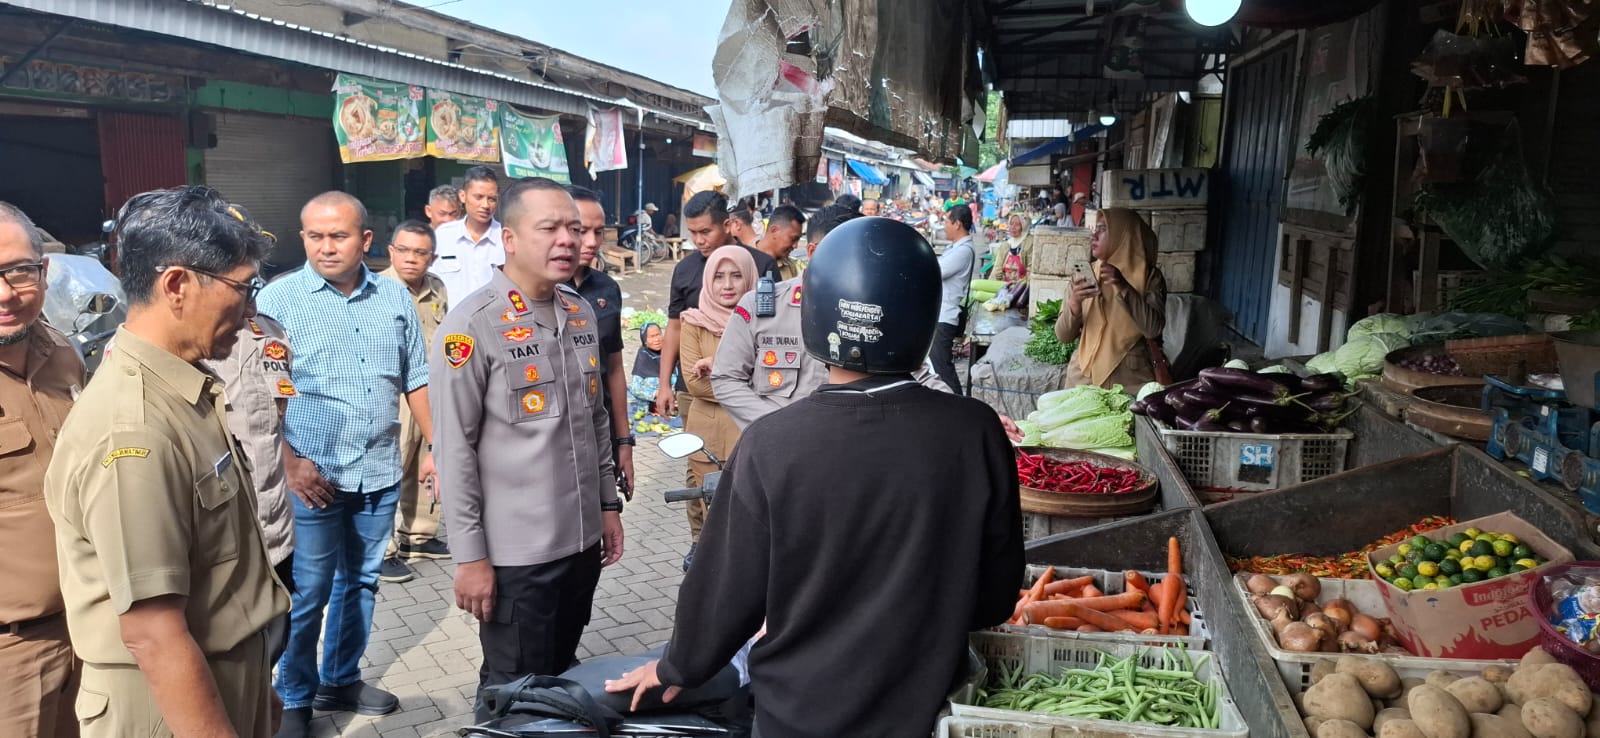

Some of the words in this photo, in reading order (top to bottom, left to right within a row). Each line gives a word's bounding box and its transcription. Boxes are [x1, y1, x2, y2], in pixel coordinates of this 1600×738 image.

[1122, 172, 1205, 201] MTR
[573, 334, 596, 347] POLRI
[509, 343, 540, 360] TAAT
[263, 361, 289, 372] POLR
[1242, 445, 1273, 466] SH
[1480, 607, 1533, 631] PEDA
